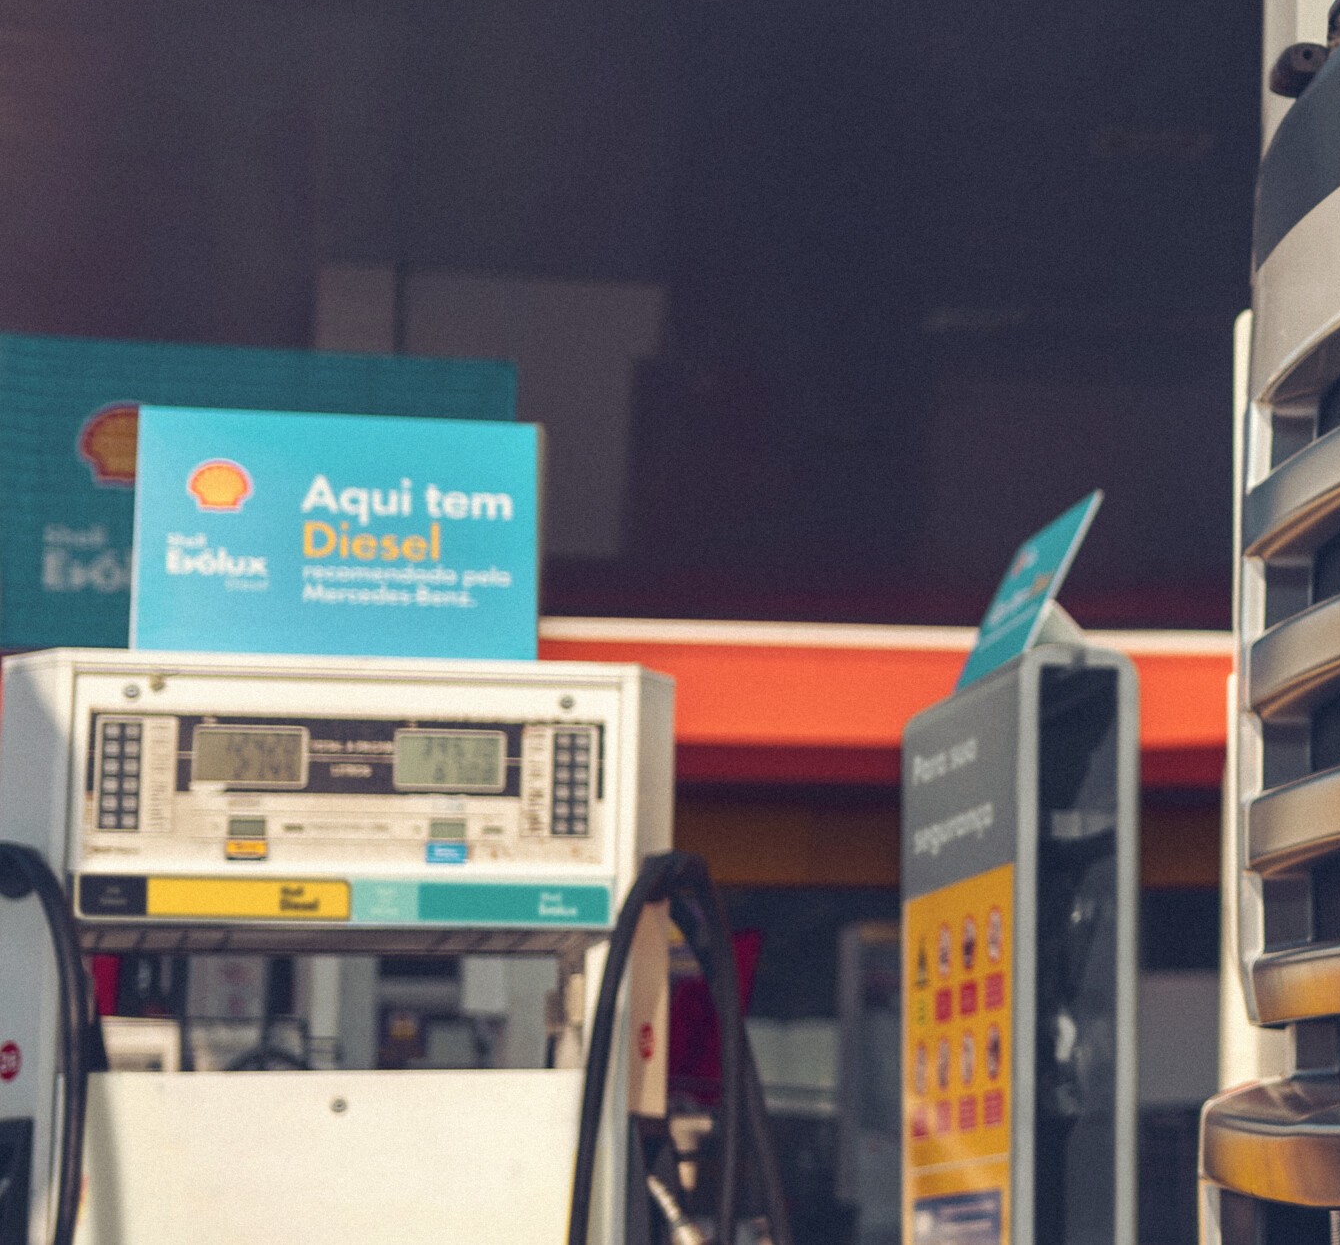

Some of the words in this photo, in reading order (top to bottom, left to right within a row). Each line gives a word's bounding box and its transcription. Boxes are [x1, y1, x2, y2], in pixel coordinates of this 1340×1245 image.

[302, 473, 412, 526] Aqui
[426, 483, 512, 521] tem
[303, 520, 441, 562] Diesel
